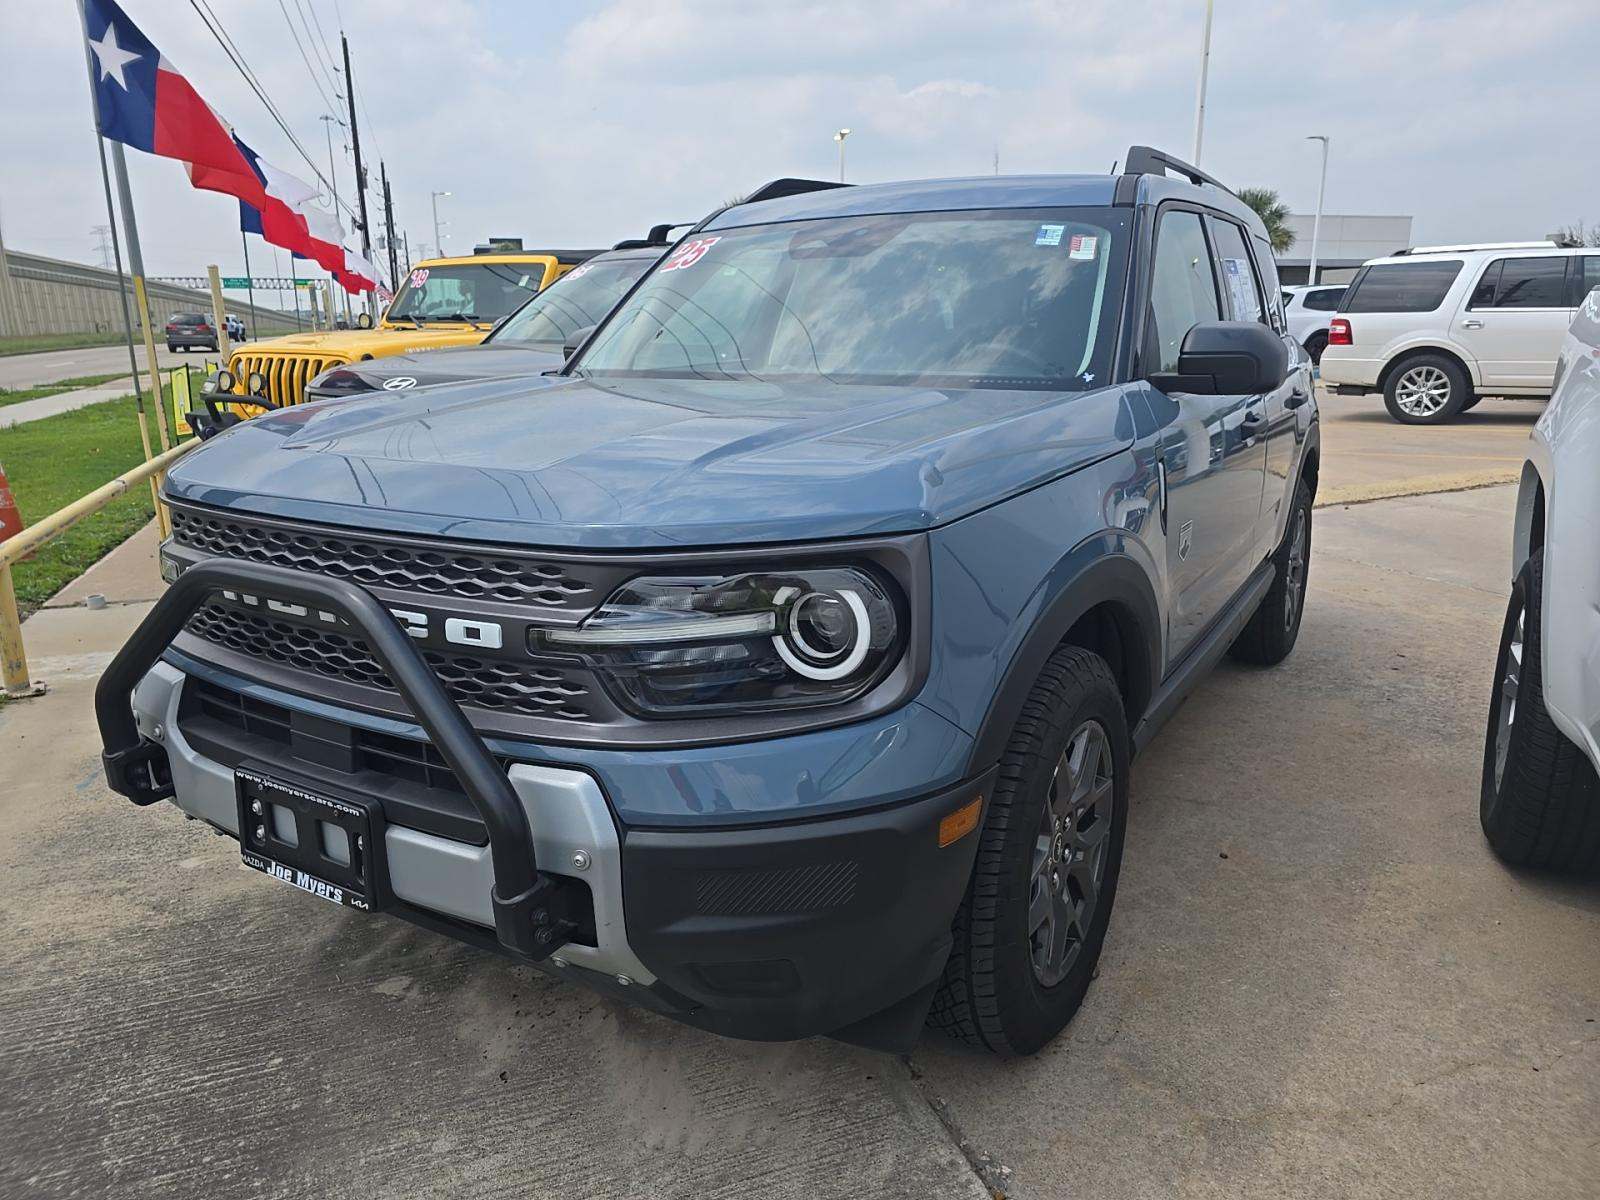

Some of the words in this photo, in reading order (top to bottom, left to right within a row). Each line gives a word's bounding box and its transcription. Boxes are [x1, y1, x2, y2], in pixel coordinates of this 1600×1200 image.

[235, 771, 360, 817] www.joemyerscars.com
[266, 861, 292, 882] Joe
[297, 871, 343, 902] Myers
